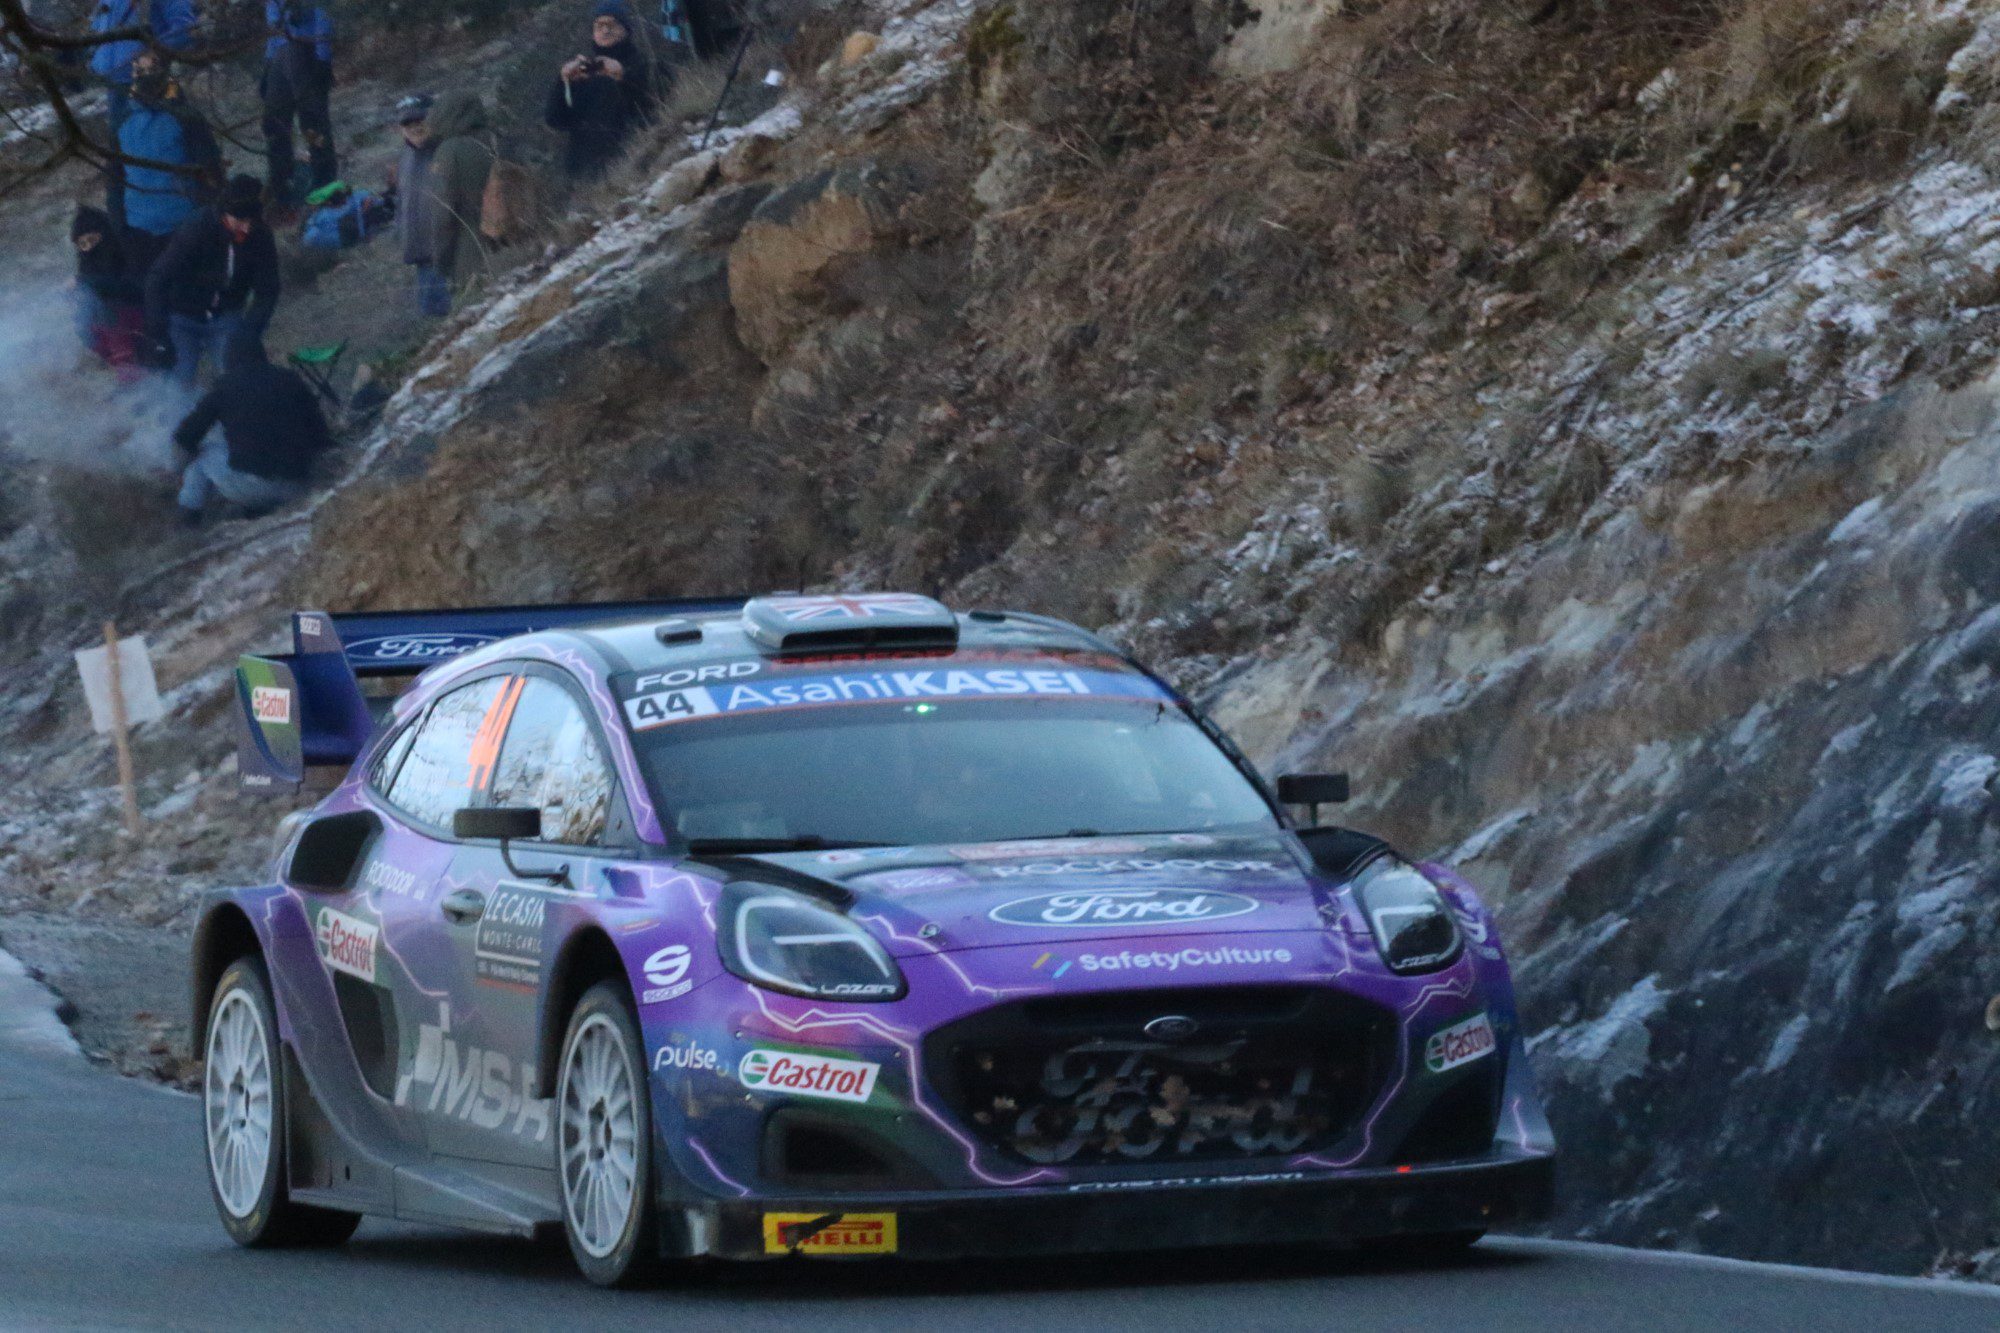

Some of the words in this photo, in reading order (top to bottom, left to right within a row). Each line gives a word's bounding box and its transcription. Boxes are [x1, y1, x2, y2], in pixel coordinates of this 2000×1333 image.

[635, 661, 761, 692] FORD
[635, 691, 696, 721] 44
[1041, 890, 1213, 922] Ford
[331, 918, 372, 973] Castrol
[1079, 945, 1292, 972] SafetyCulture
[768, 1058, 868, 1096] Castrol
